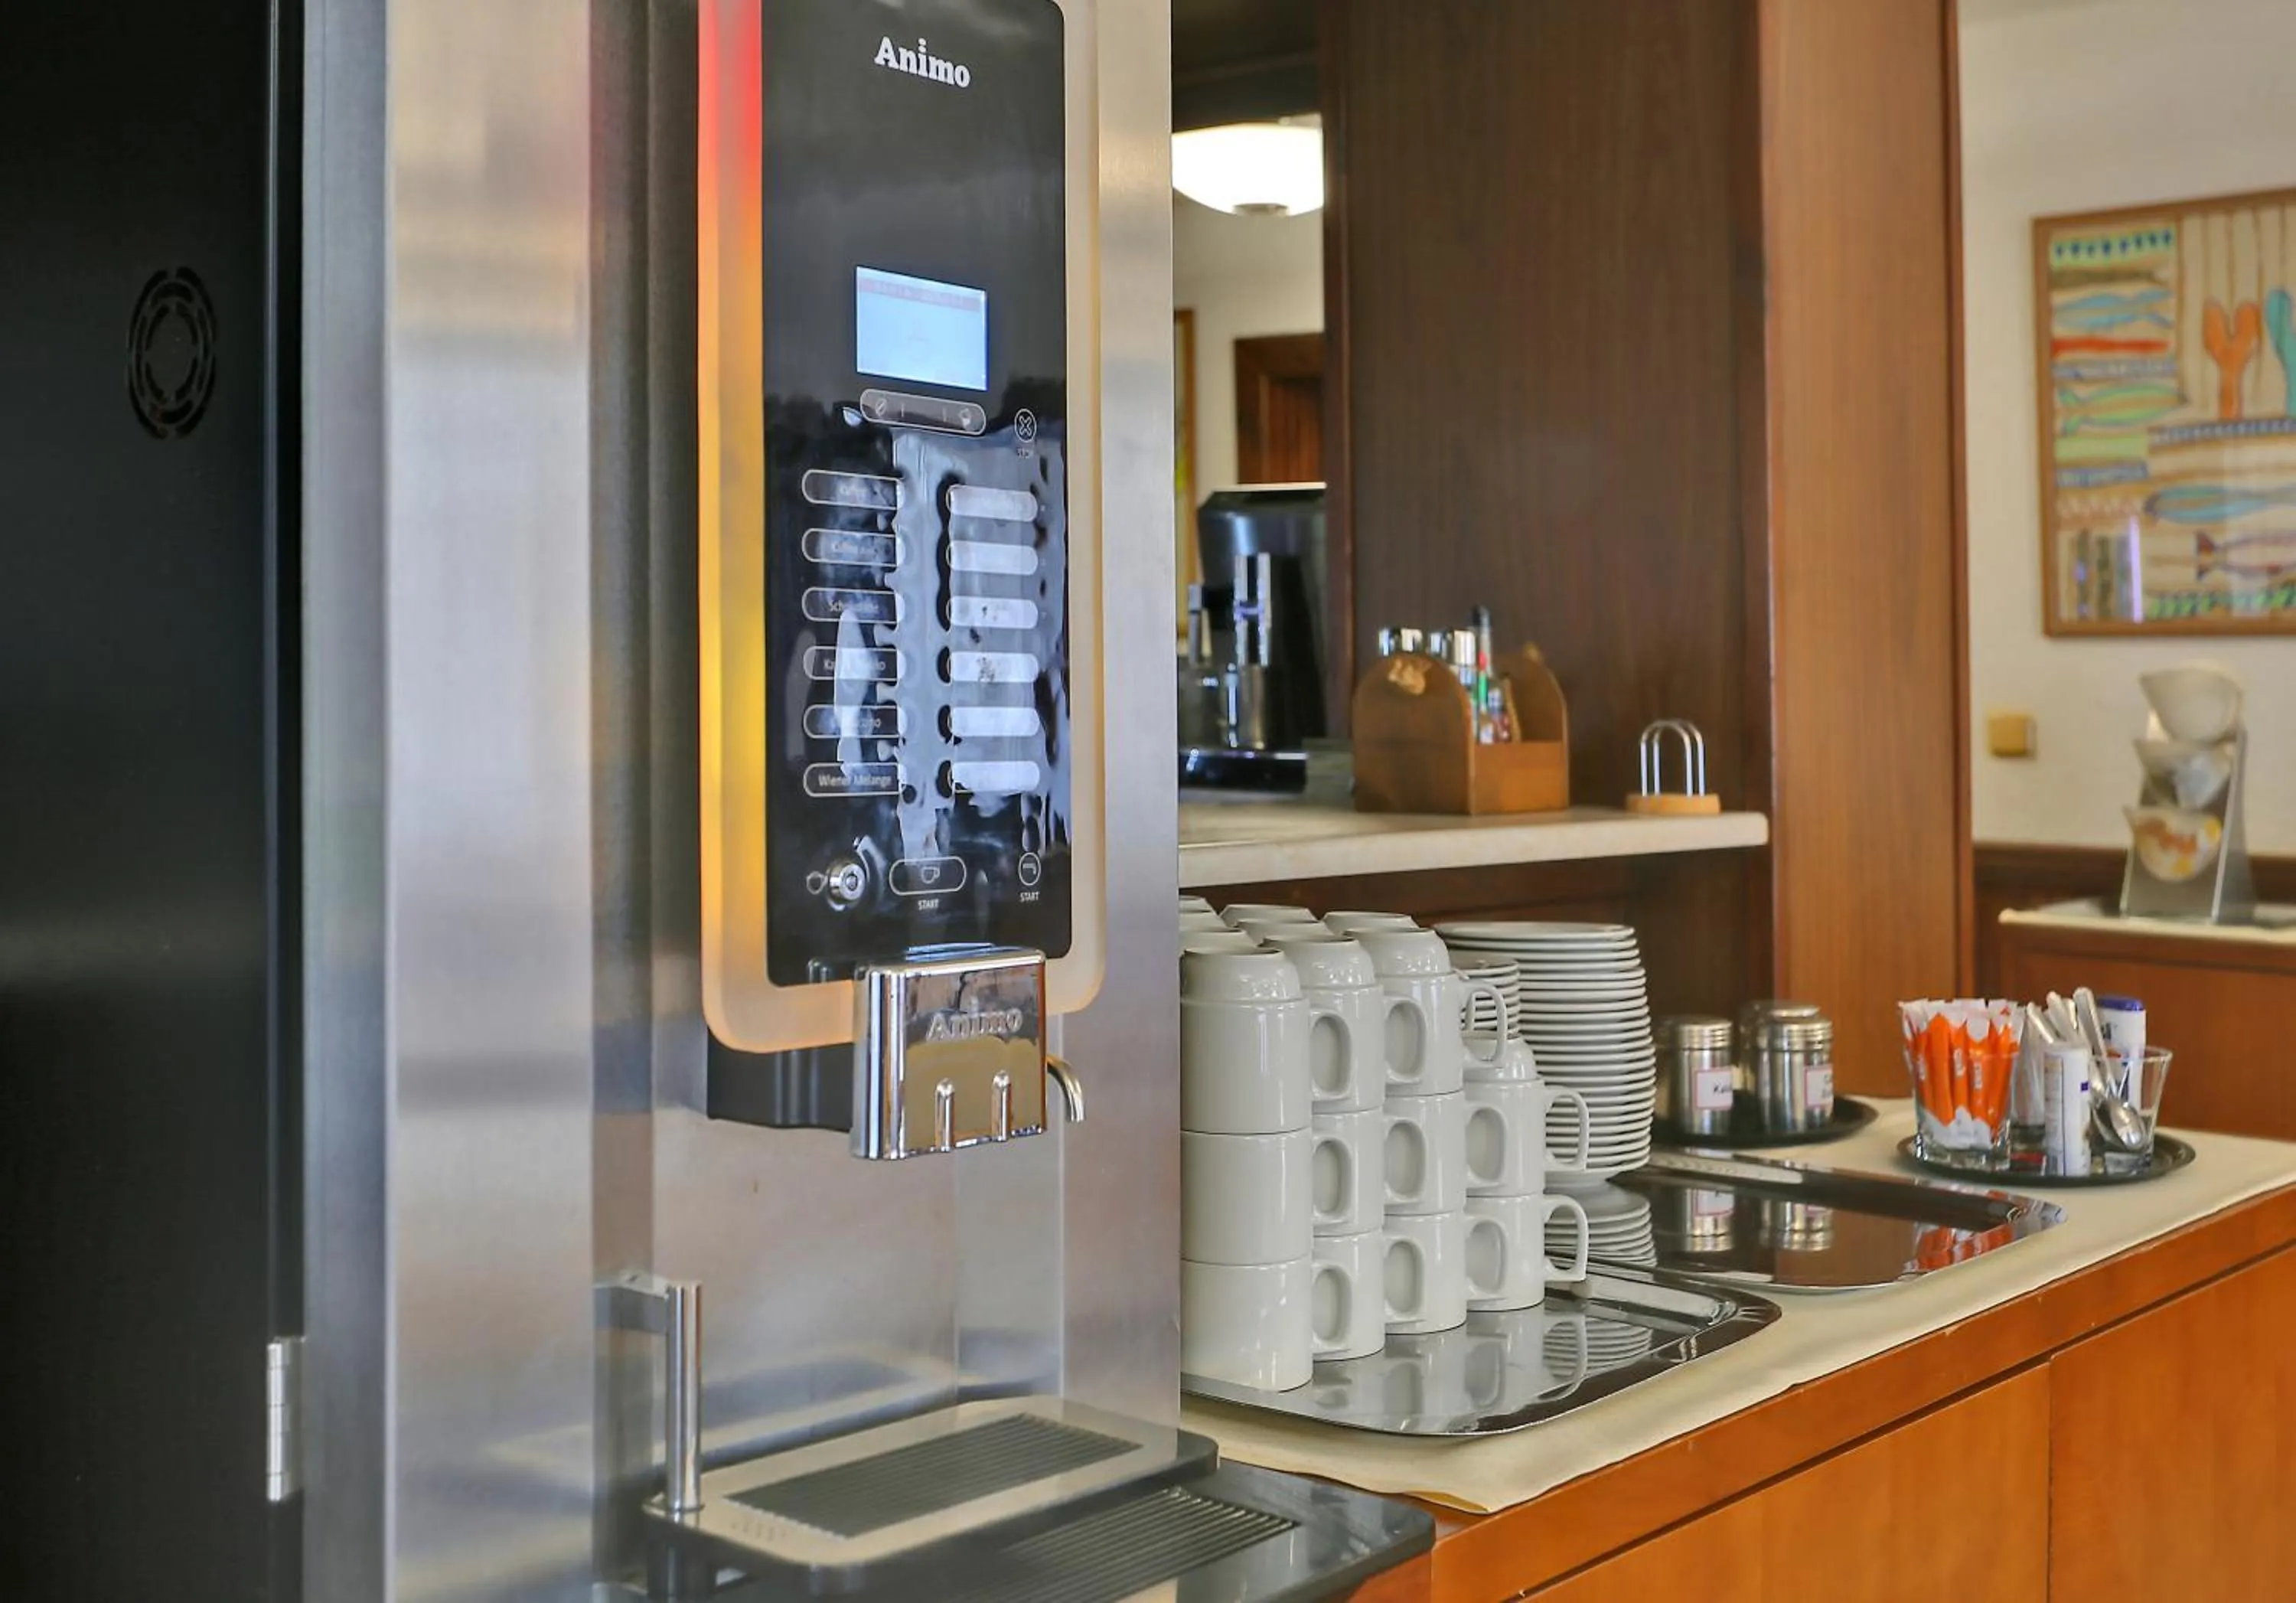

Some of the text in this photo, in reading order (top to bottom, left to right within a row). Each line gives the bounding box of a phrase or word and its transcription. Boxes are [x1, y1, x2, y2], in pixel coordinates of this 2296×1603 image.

[874, 36, 970, 88] Animo
[918, 899, 939, 910] START
[1019, 891, 1039, 902] START
[925, 995, 1023, 1042] Animo
